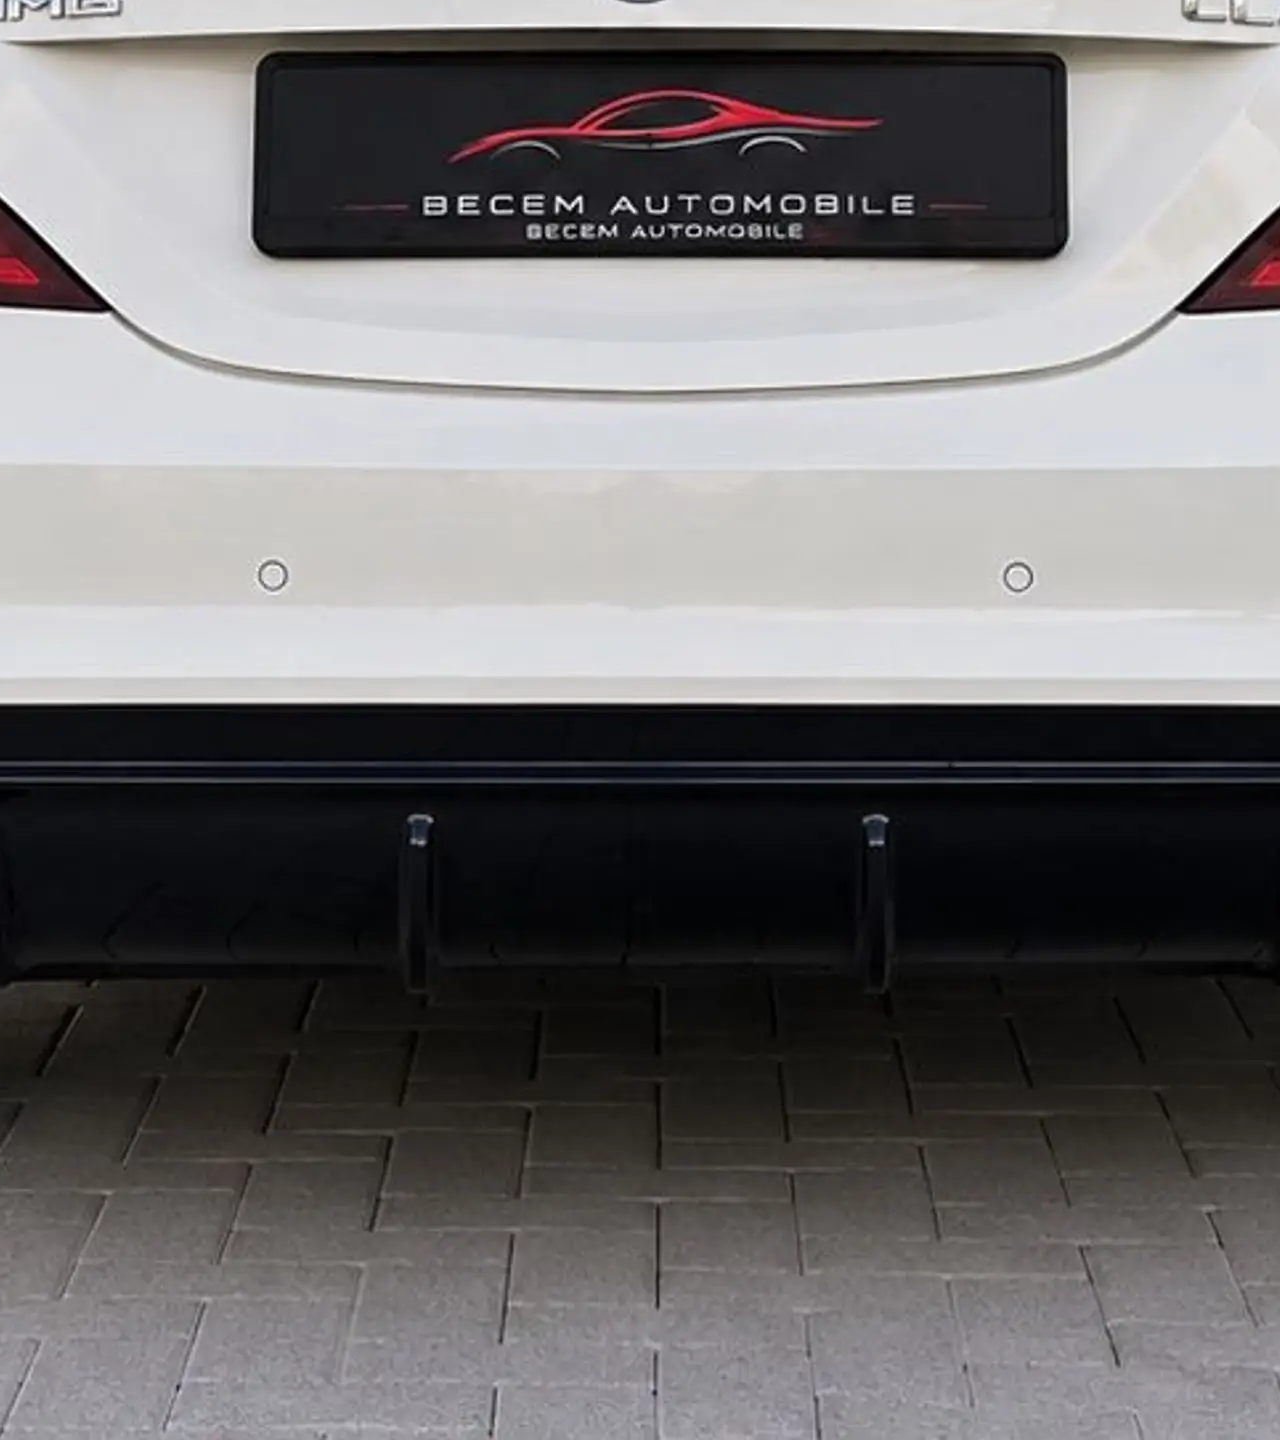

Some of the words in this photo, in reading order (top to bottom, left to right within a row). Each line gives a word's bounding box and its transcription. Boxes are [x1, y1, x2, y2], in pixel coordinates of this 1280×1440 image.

[422, 194, 586, 216] BECEM
[609, 194, 916, 216] AUTOMOBILE
[525, 222, 620, 241] BECEM
[629, 222, 805, 241] AUTOMOBILE
